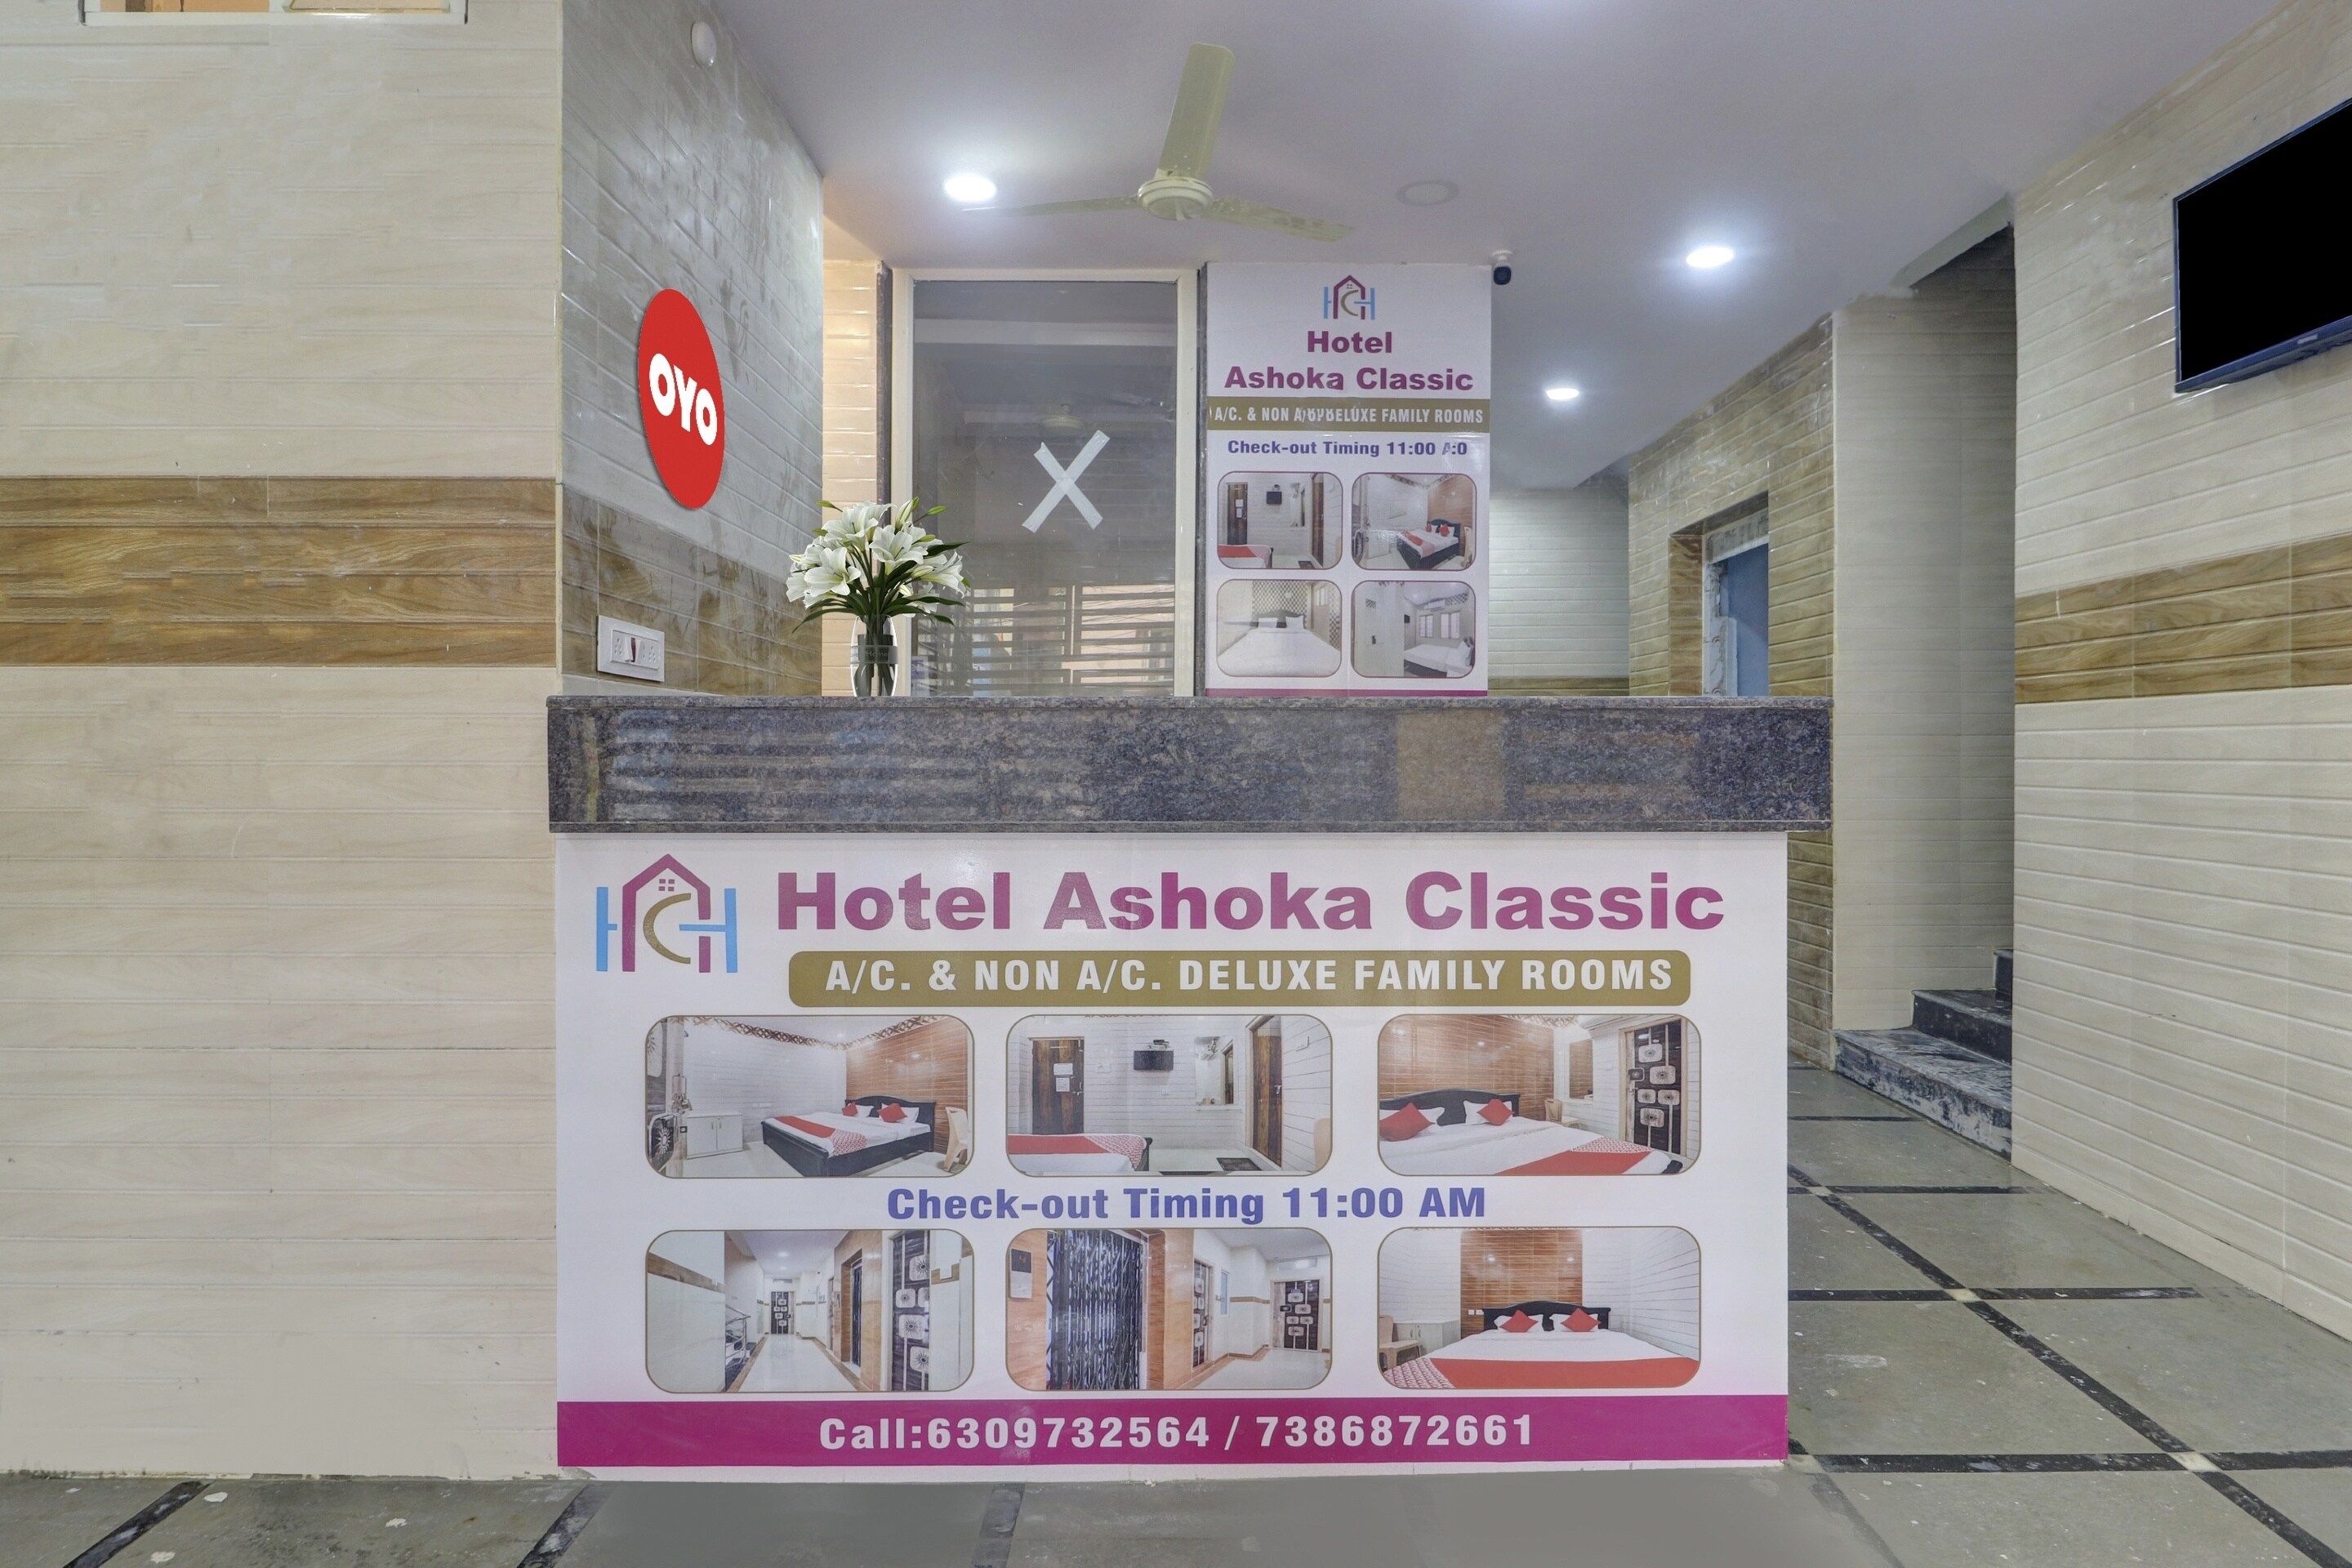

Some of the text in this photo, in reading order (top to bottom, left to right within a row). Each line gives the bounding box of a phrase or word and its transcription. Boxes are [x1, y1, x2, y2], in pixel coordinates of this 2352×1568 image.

[1307, 330, 1392, 354] Hotel
[1224, 366, 1473, 391] Ashoka Classic
[649, 353, 718, 445] OYO
[1214, 407, 1242, 422] A/C.
[1246, 407, 1257, 421] &
[1262, 407, 1290, 421] NON
[1381, 408, 1430, 423] FAMILY
[1434, 409, 1483, 424] ROOMS
[1227, 439, 1317, 455] Check-out
[1322, 441, 1379, 457] Timing
[1386, 442, 1436, 456] 11:00
[777, 871, 1725, 932] Hotel Ashoka Classic
[826, 959, 1672, 993] A/C. & NON A/C. DELUXE FAMILY ROOMS
[888, 1187, 1486, 1225] Check-out Timing 11:00 AM
[1224, 1415, 1240, 1450] /
[1255, 1414, 1532, 1447] 7386872661
